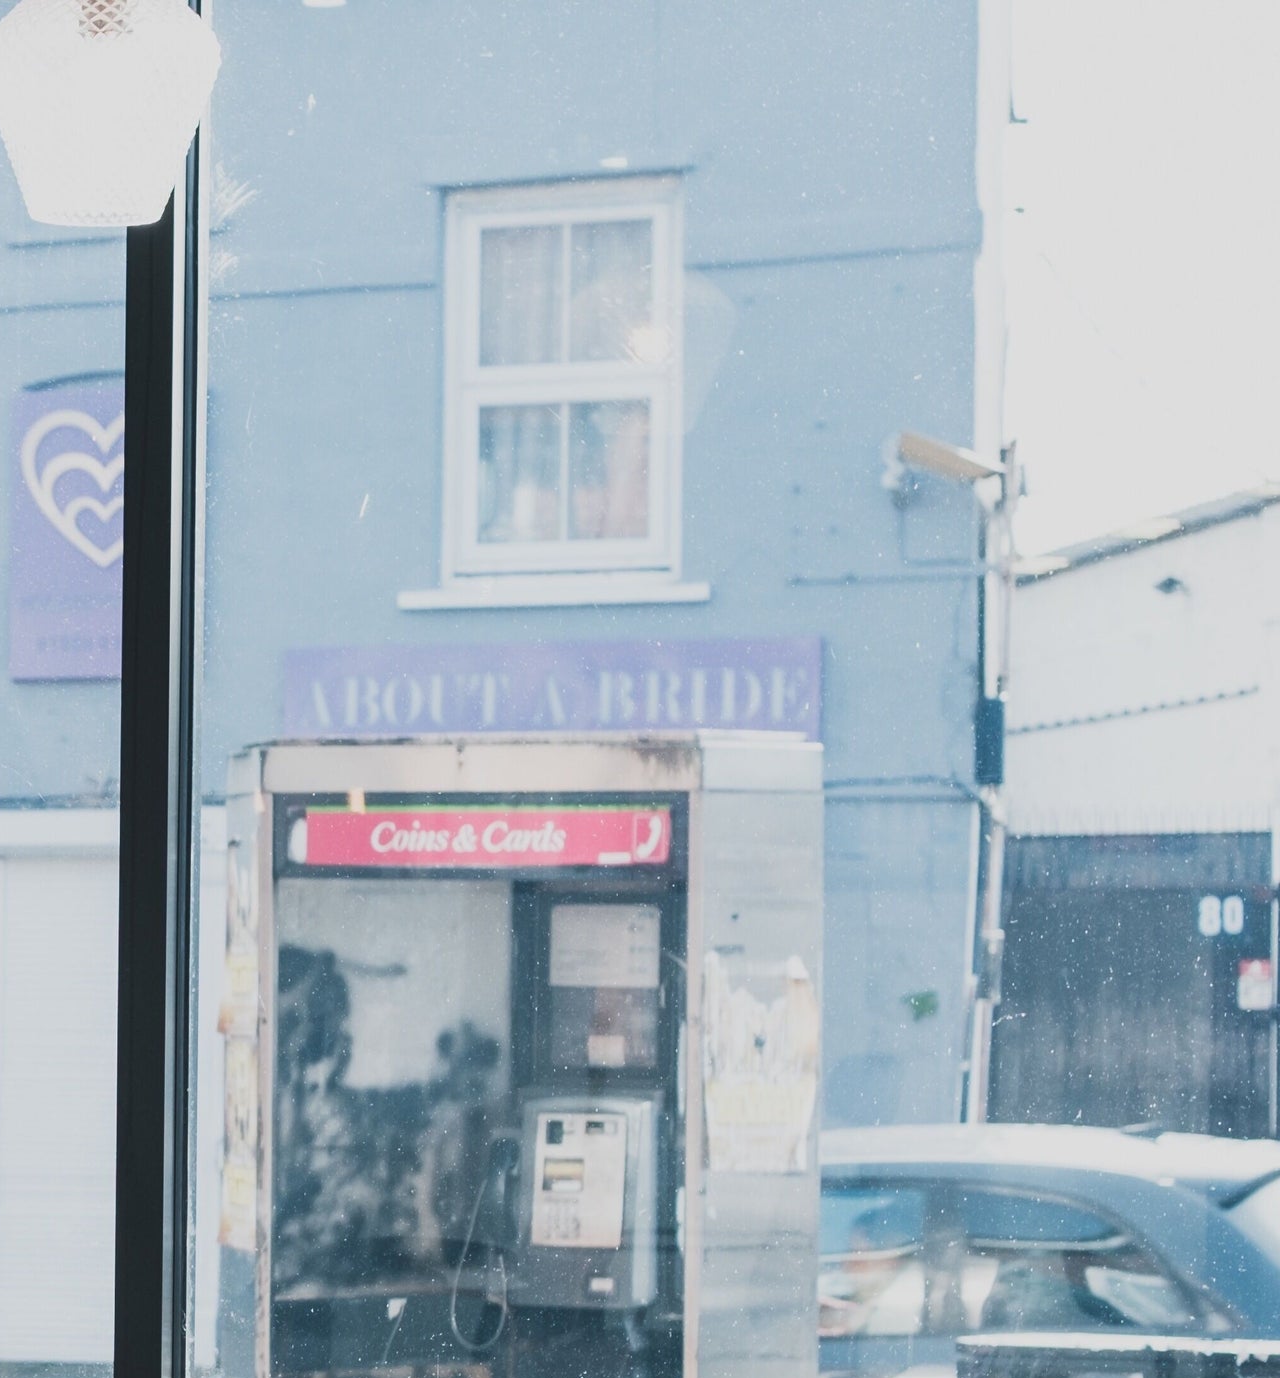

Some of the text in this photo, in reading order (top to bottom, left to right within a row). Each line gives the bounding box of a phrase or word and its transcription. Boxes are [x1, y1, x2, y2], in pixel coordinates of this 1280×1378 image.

[306, 666, 810, 728] ABOUT A BRIDE
[370, 820, 567, 853] Coins & Cards
